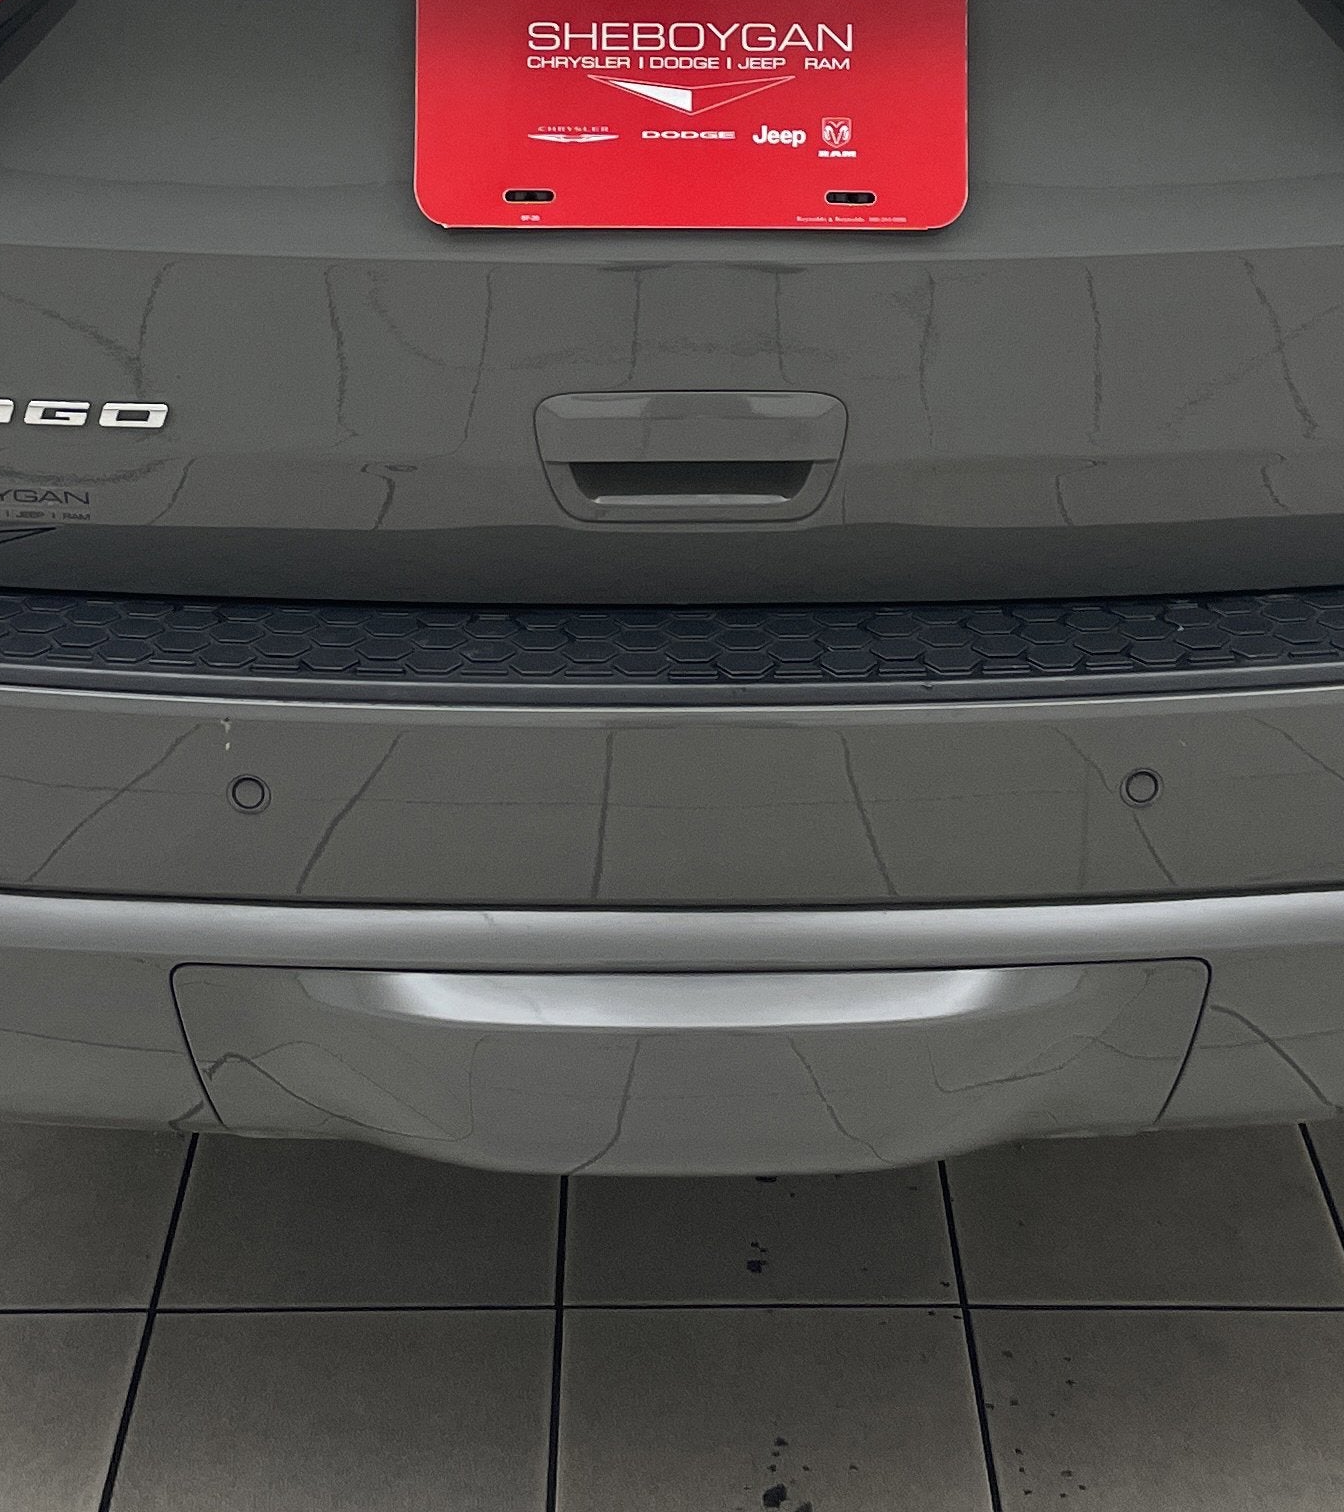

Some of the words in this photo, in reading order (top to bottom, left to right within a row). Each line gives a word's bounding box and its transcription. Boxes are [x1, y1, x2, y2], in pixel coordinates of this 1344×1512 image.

[526, 21, 853, 53] SHEBOYGAN
[526, 55, 631, 70] CHRYSLER
[649, 57, 720, 70] DODGE
[737, 57, 787, 70] JEEP
[804, 57, 851, 70] RAM
[537, 125, 610, 133] CHRYSLER
[641, 130, 737, 140] DODGE
[751, 124, 807, 148] Jeep
[817, 149, 857, 158] RAM
[16, 510, 45, 519] JEEP
[62, 512, 91, 521] RAM
